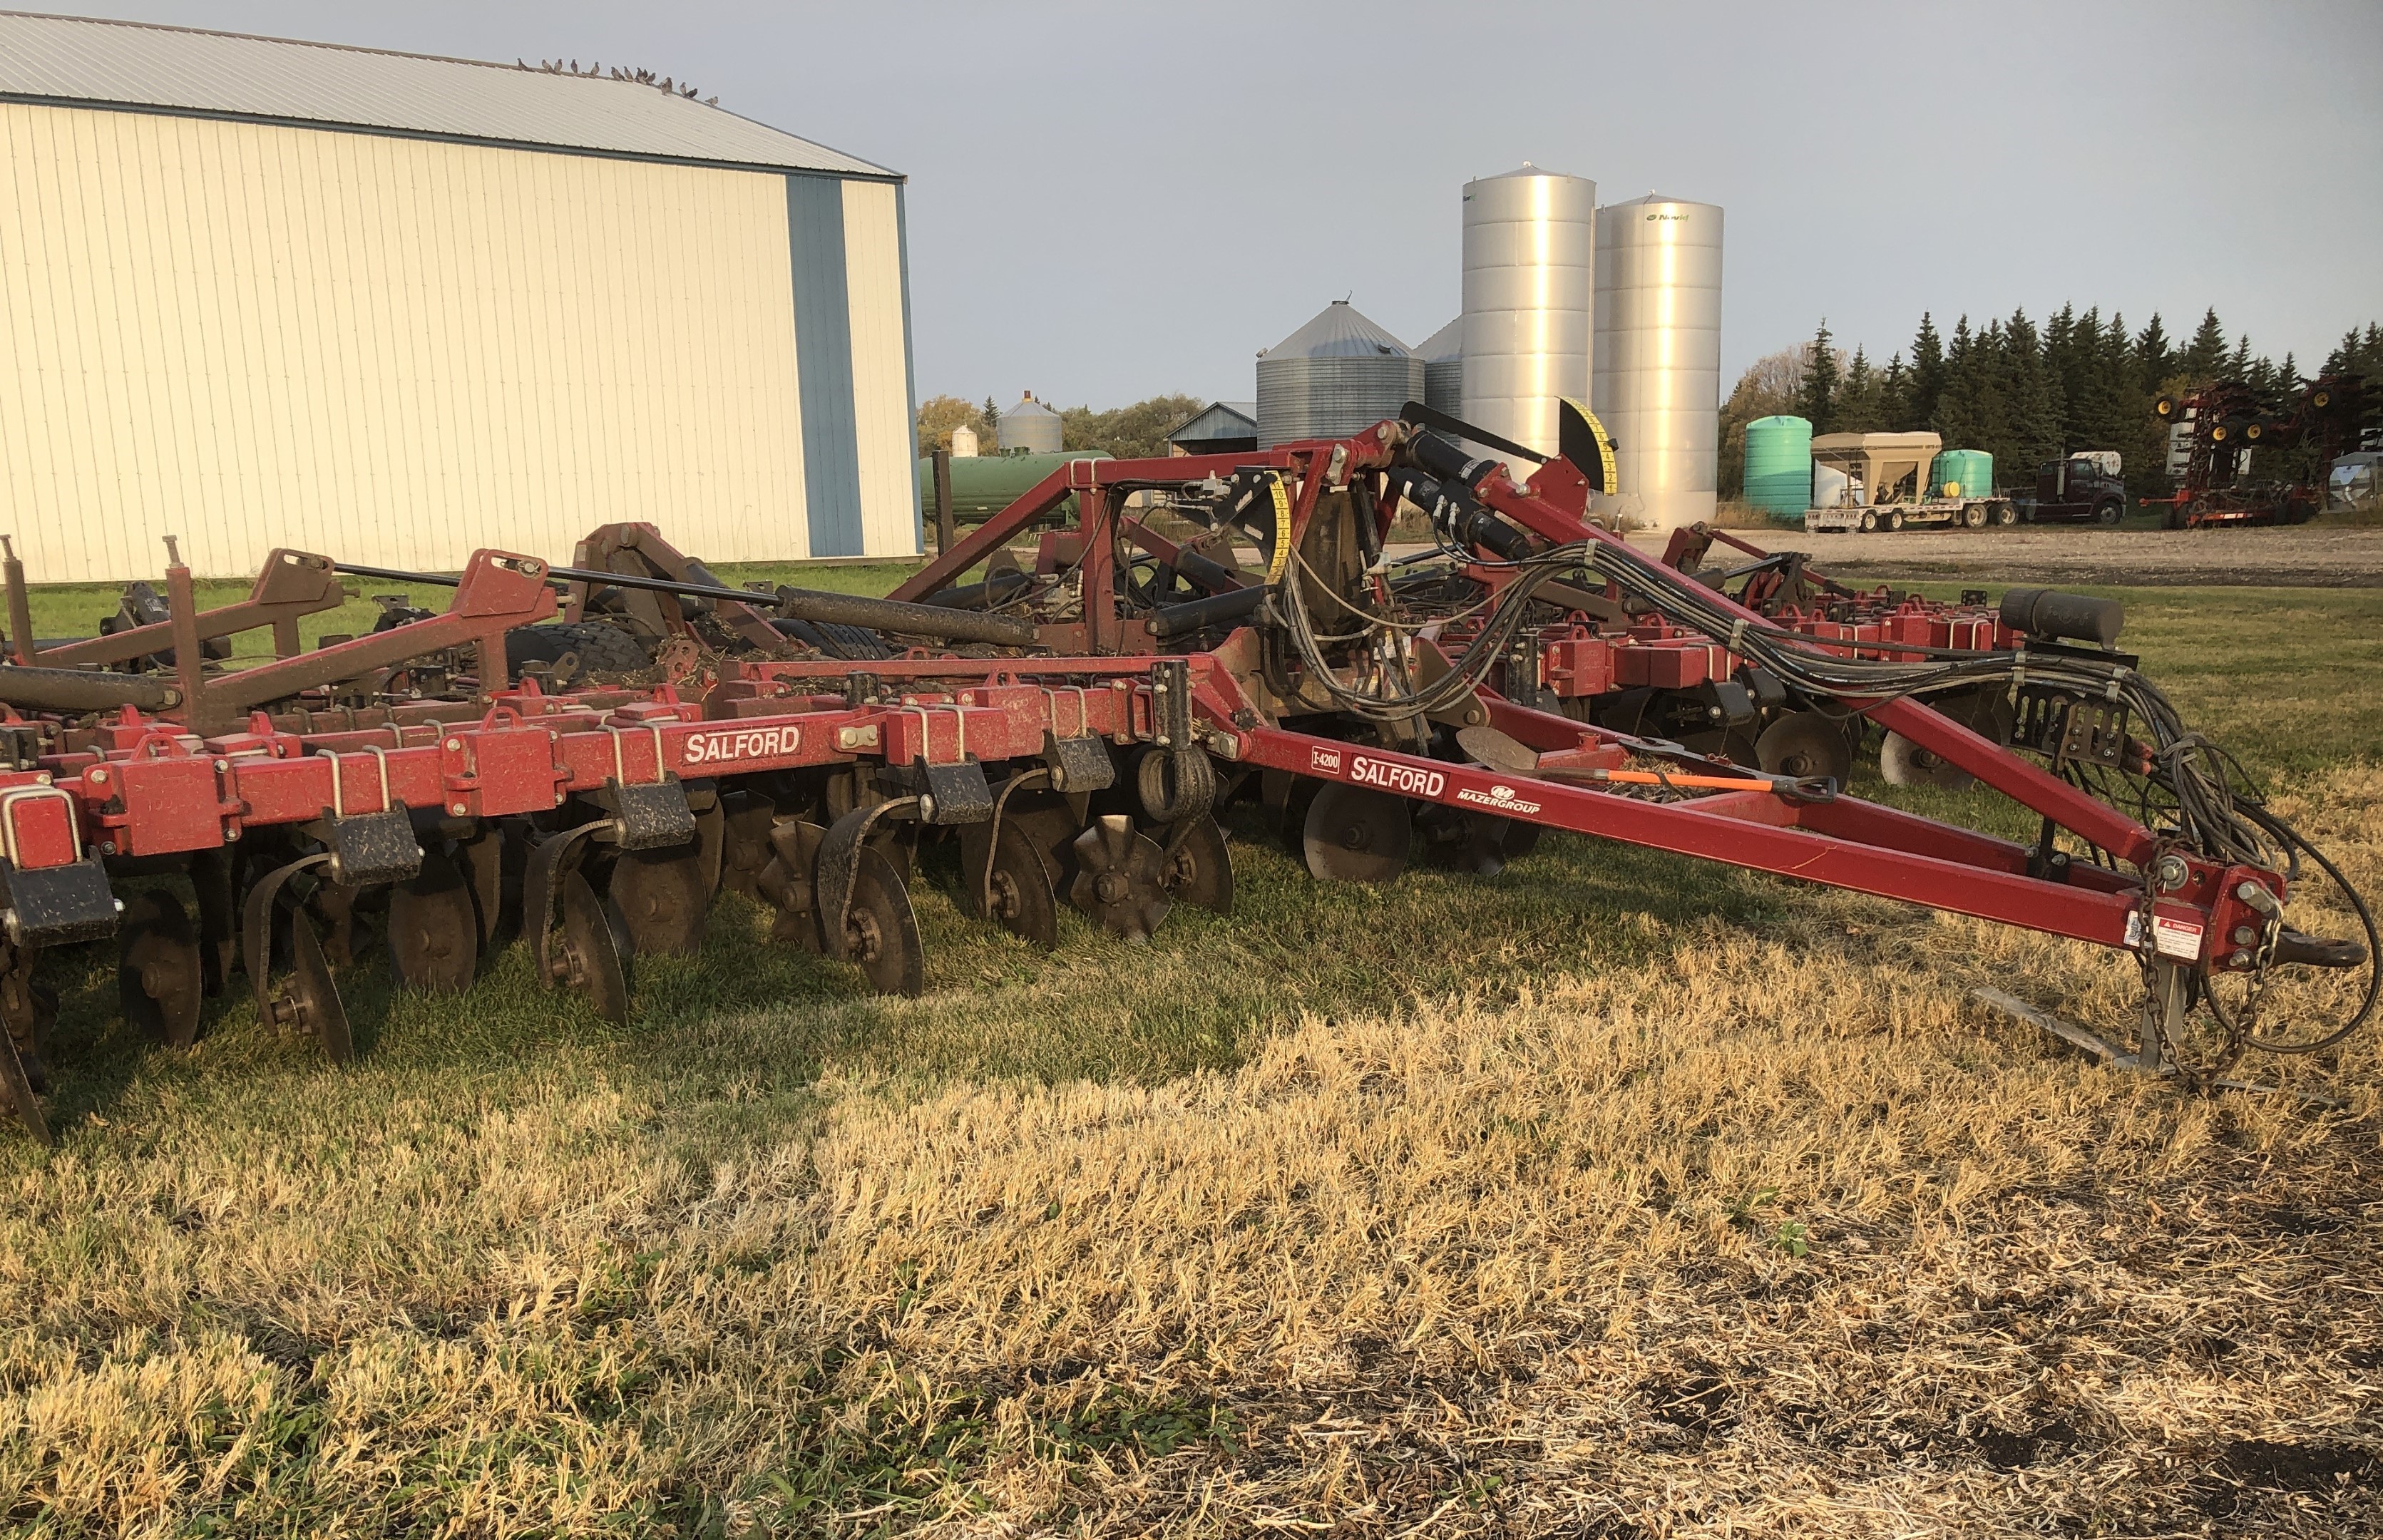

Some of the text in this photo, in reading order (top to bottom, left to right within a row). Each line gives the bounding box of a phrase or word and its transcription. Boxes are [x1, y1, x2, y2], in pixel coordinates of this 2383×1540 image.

[1609, 473, 1613, 482] 2
[685, 727, 799, 763] SALFORD
[1313, 751, 1338, 769] I-4200
[1351, 756, 1445, 797] SALFORD
[1457, 791, 1540, 814] MAZERGROUP
[2172, 923, 2197, 933] DANGER
